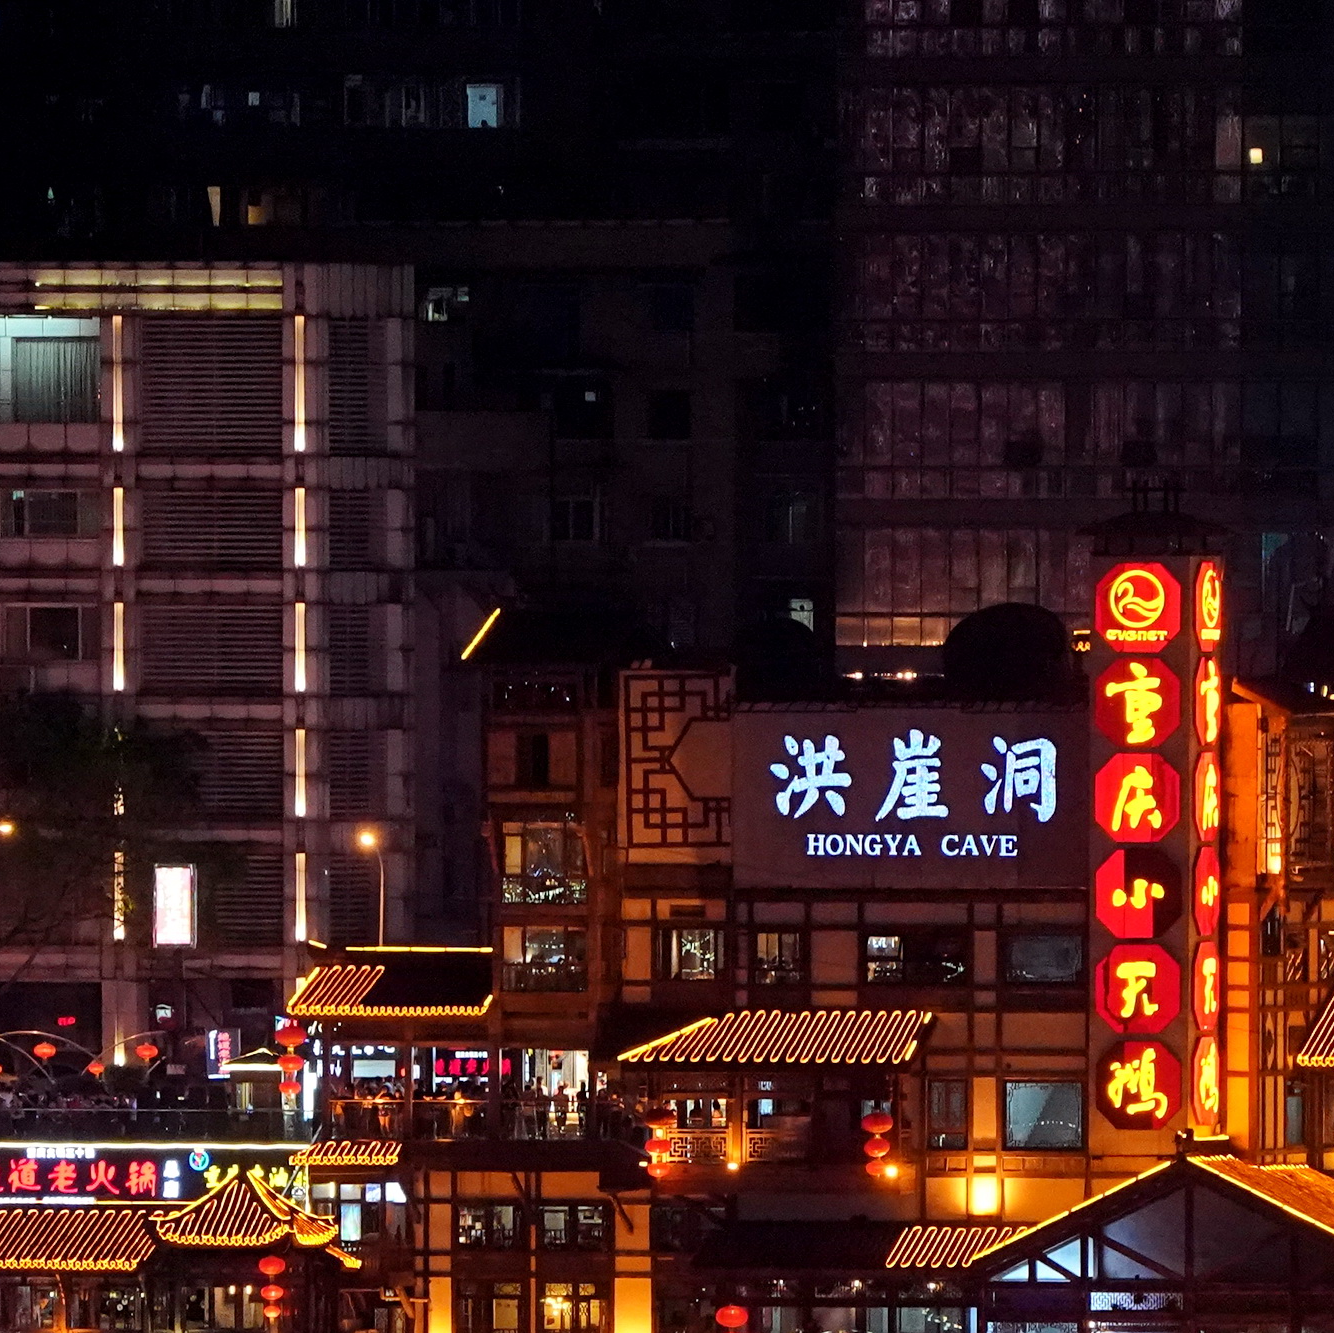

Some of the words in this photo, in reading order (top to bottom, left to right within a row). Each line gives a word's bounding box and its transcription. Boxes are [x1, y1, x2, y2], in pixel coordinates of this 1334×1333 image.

[770, 729, 1057, 823] 洪崖洞
[807, 834, 922, 857] HONGYA
[941, 834, 1019, 857] CAVE
[1105, 661, 1169, 1119] 重庆小天鹅
